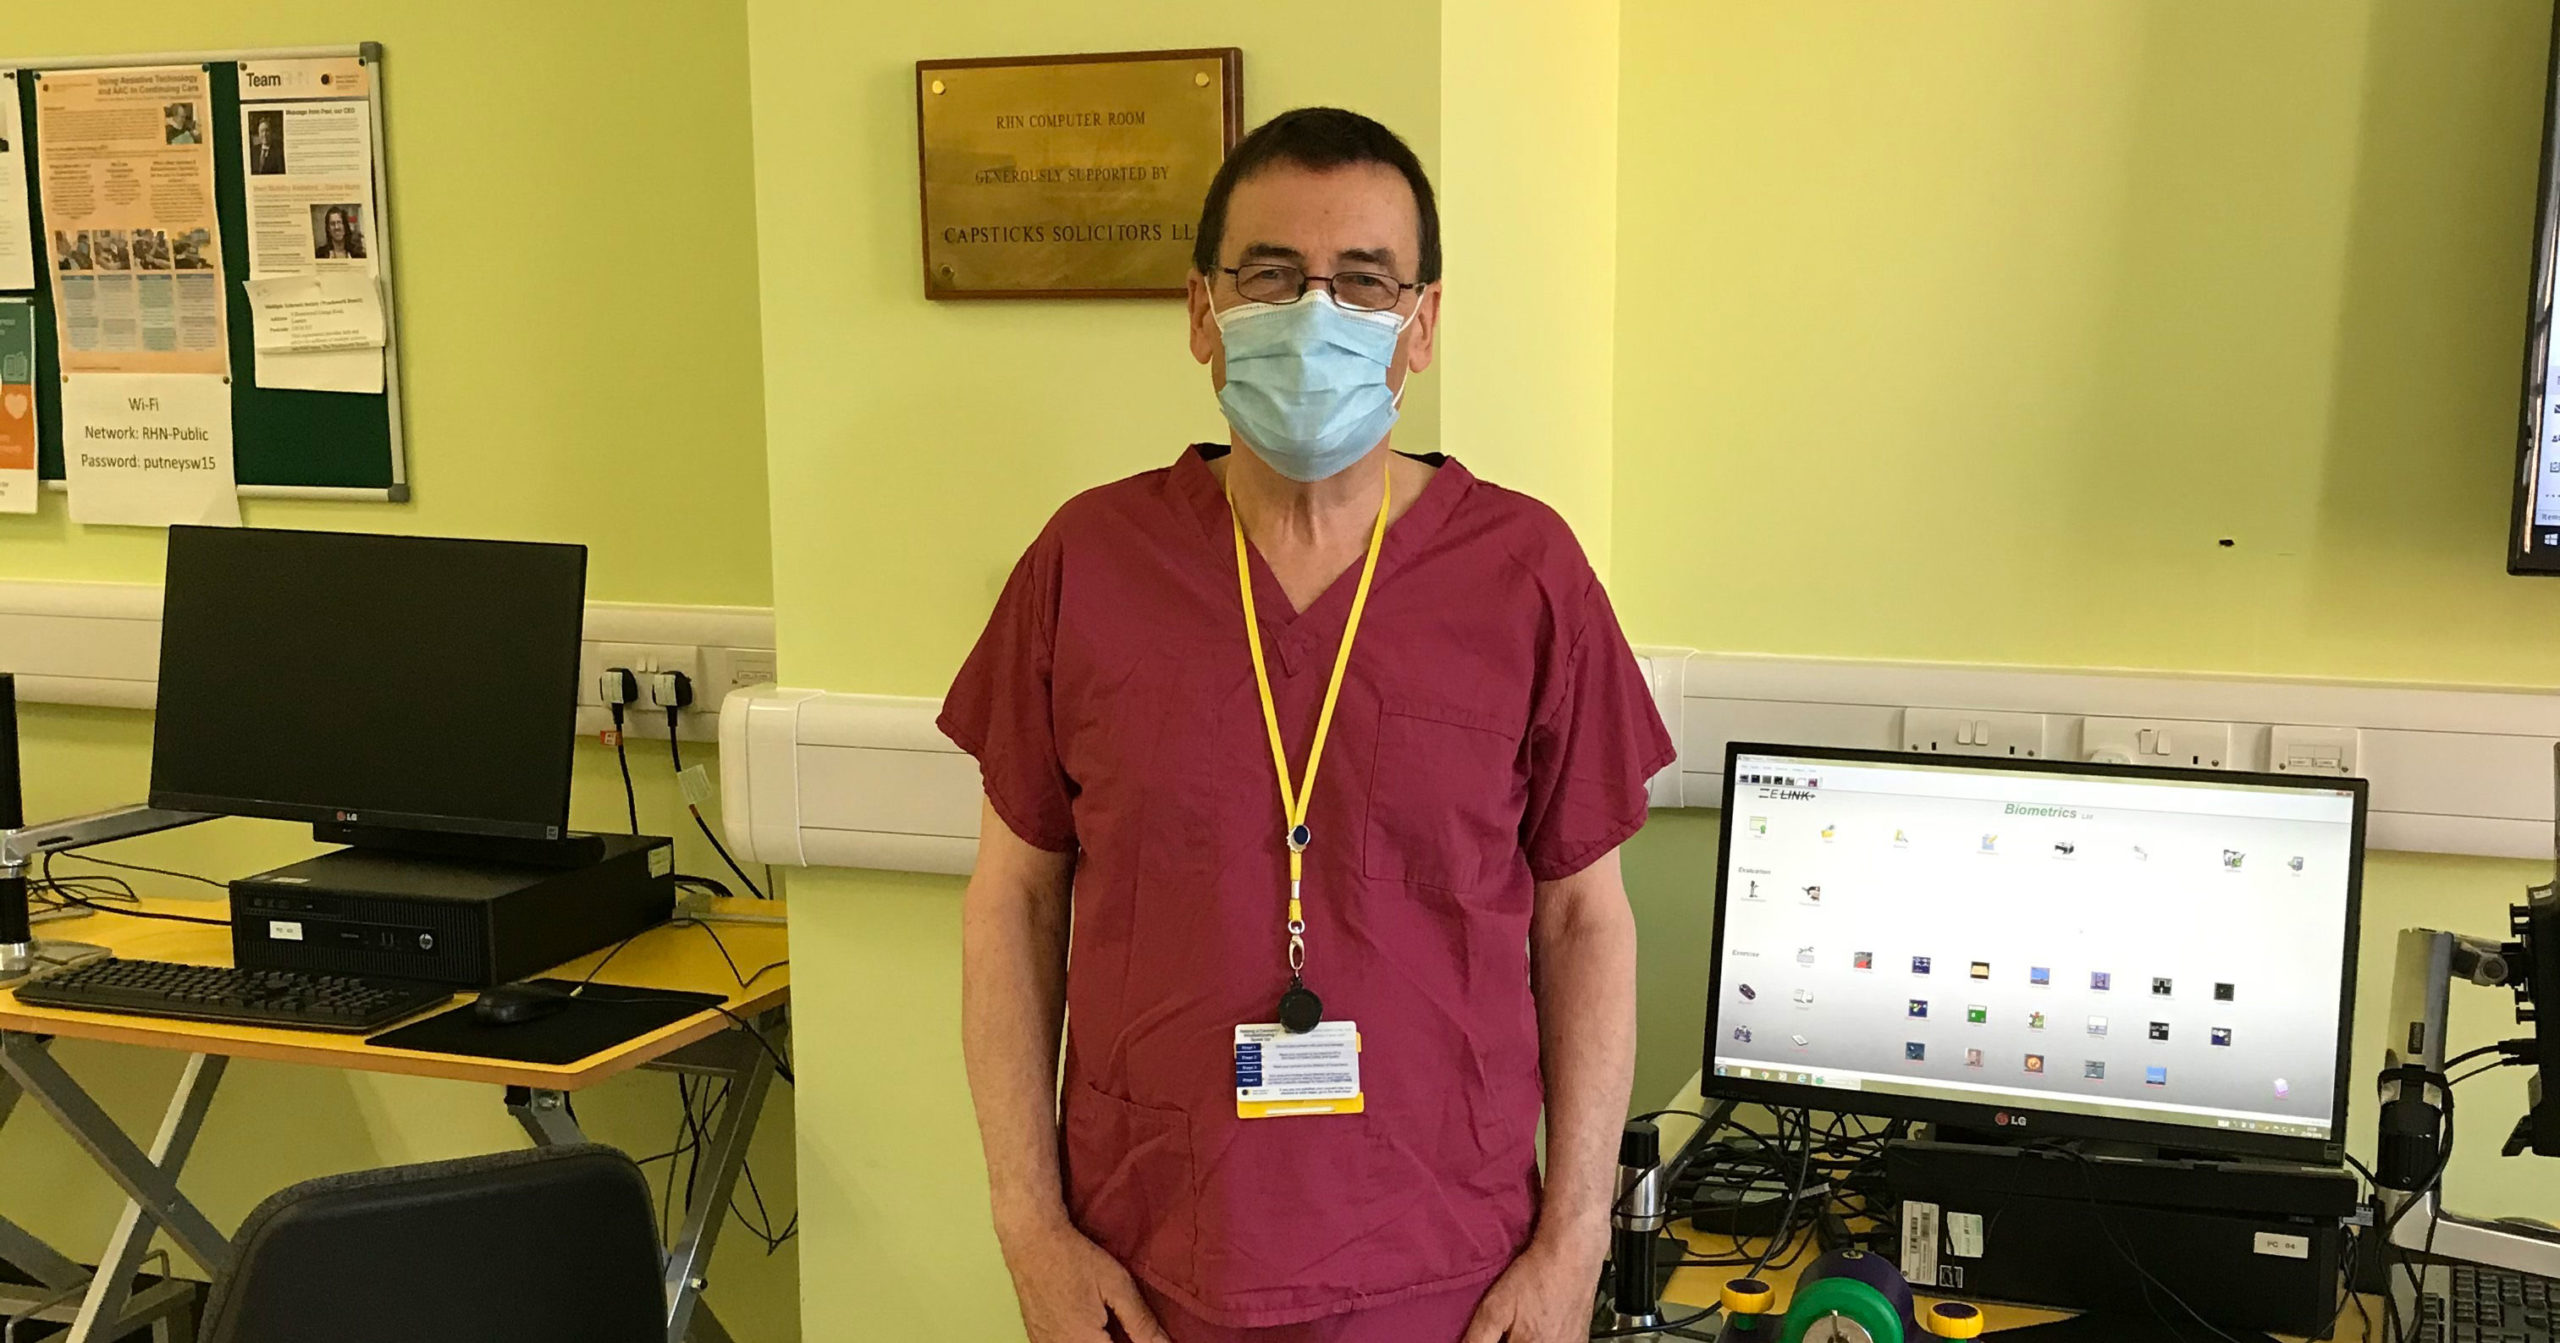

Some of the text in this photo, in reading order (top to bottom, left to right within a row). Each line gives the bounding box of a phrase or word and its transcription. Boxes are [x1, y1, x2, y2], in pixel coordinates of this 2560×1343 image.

[1029, 112, 1102, 128] COMPUTER
[1108, 111, 1146, 126] ROOM
[975, 166, 1170, 184] GENEROUSLY SUPPORTED BY
[944, 223, 1199, 243] CAPSTICKS SOLICITORS LL
[128, 397, 160, 412] Wi-Fi
[85, 425, 209, 441] Network: RHN-Public
[81, 453, 216, 472] Password: putneysw15
[2004, 803, 2077, 819] Biometrics
[2011, 1115, 2027, 1126] LG
